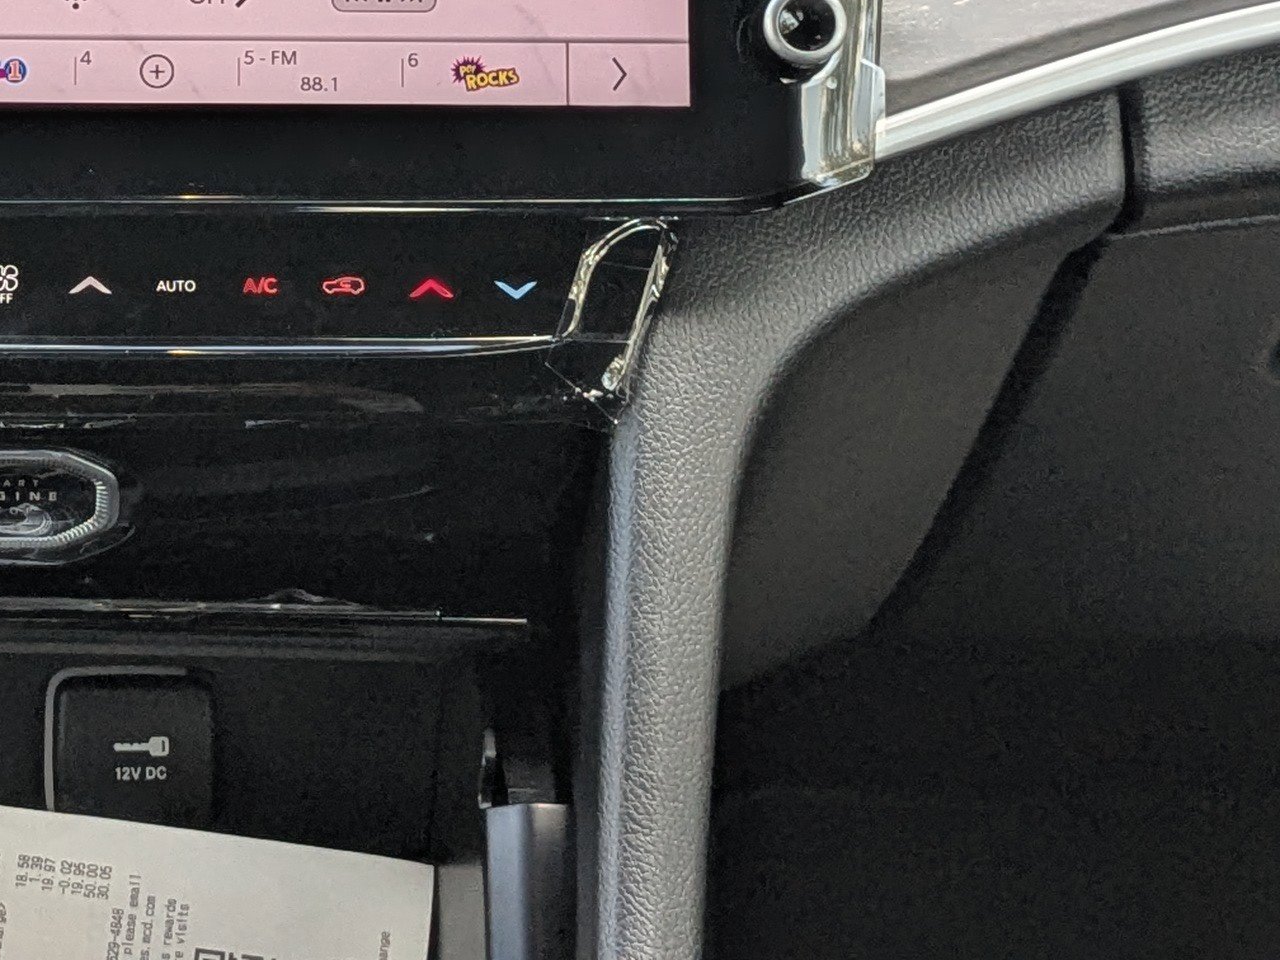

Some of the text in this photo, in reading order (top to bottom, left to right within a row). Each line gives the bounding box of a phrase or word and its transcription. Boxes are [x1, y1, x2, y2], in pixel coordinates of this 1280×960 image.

[80, 51, 92, 65] 4
[244, 50, 254, 65] 5
[271, 51, 297, 65] FM
[408, 53, 419, 67] 6
[300, 76, 338, 92] 88.1
[465, 69, 518, 90] ROCKS
[156, 279, 196, 293] AUTO
[242, 277, 279, 295] A/C
[114, 766, 168, 781] 12V DC
[122, 913, 137, 956] please
